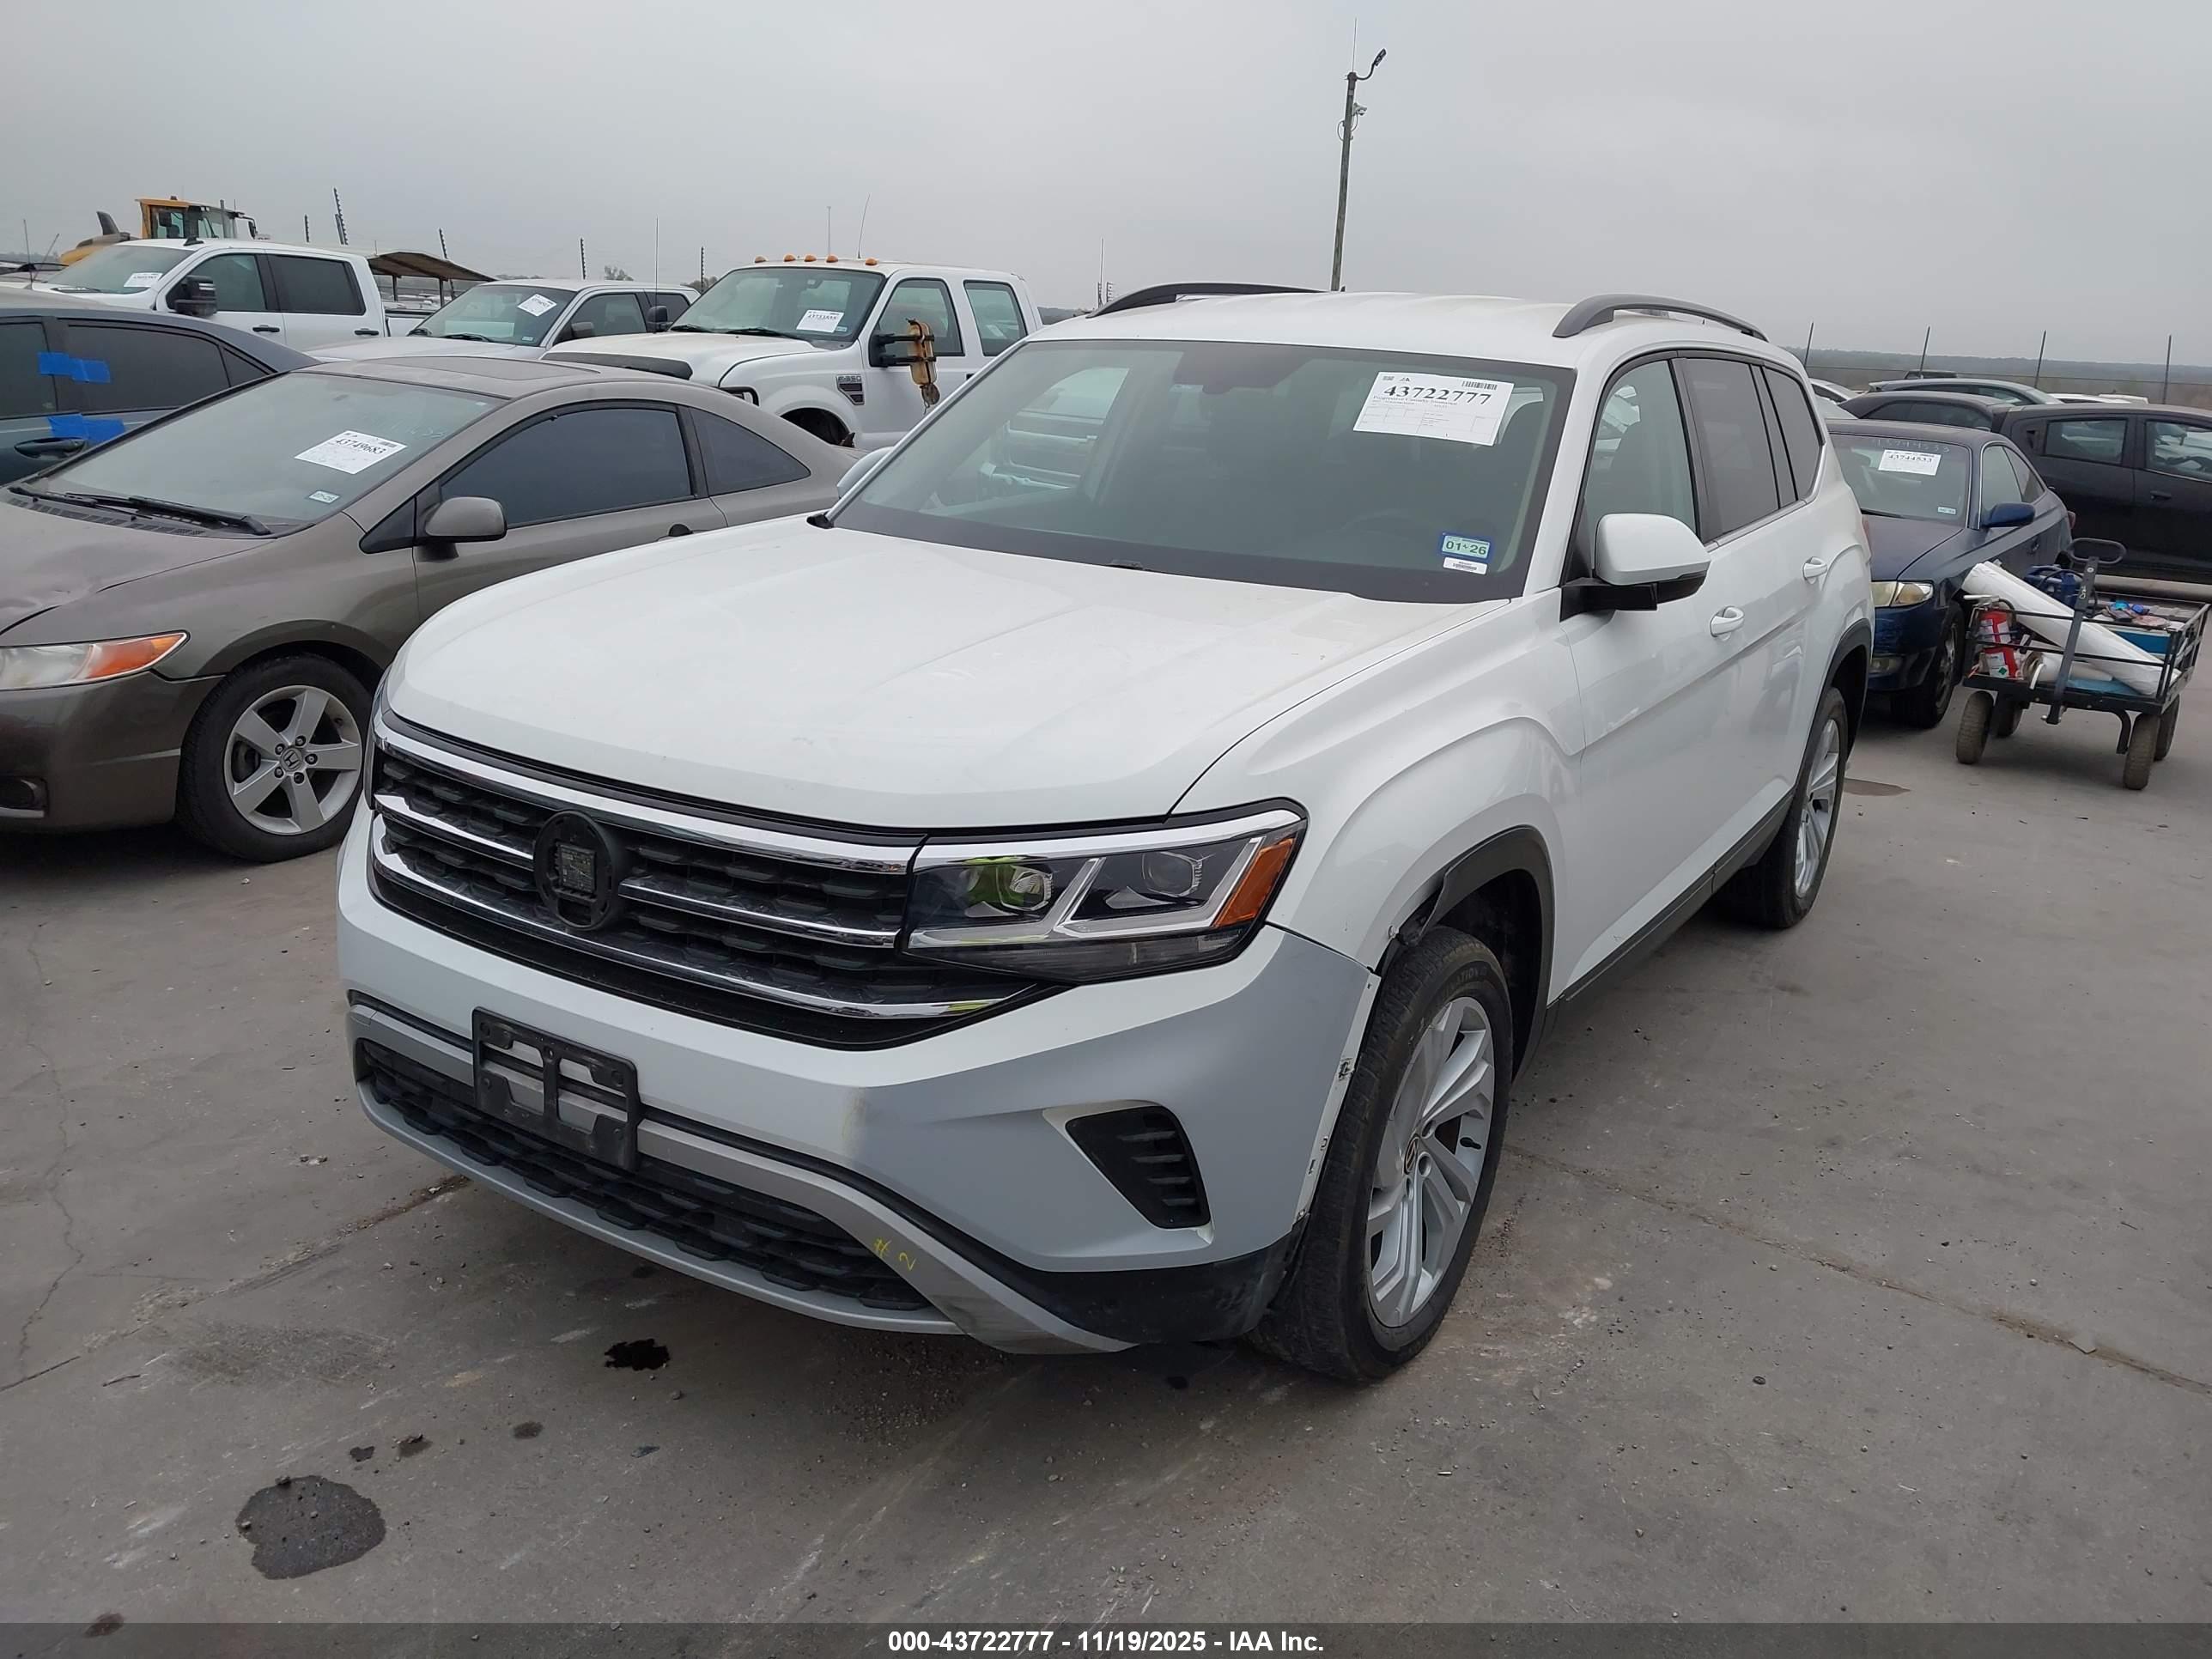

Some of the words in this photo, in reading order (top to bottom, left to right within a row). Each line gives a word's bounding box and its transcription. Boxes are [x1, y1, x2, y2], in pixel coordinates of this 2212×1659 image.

[1383, 386, 1492, 404] 43722777
[1446, 541, 1461, 550] 01
[1470, 544, 1486, 555] 26
